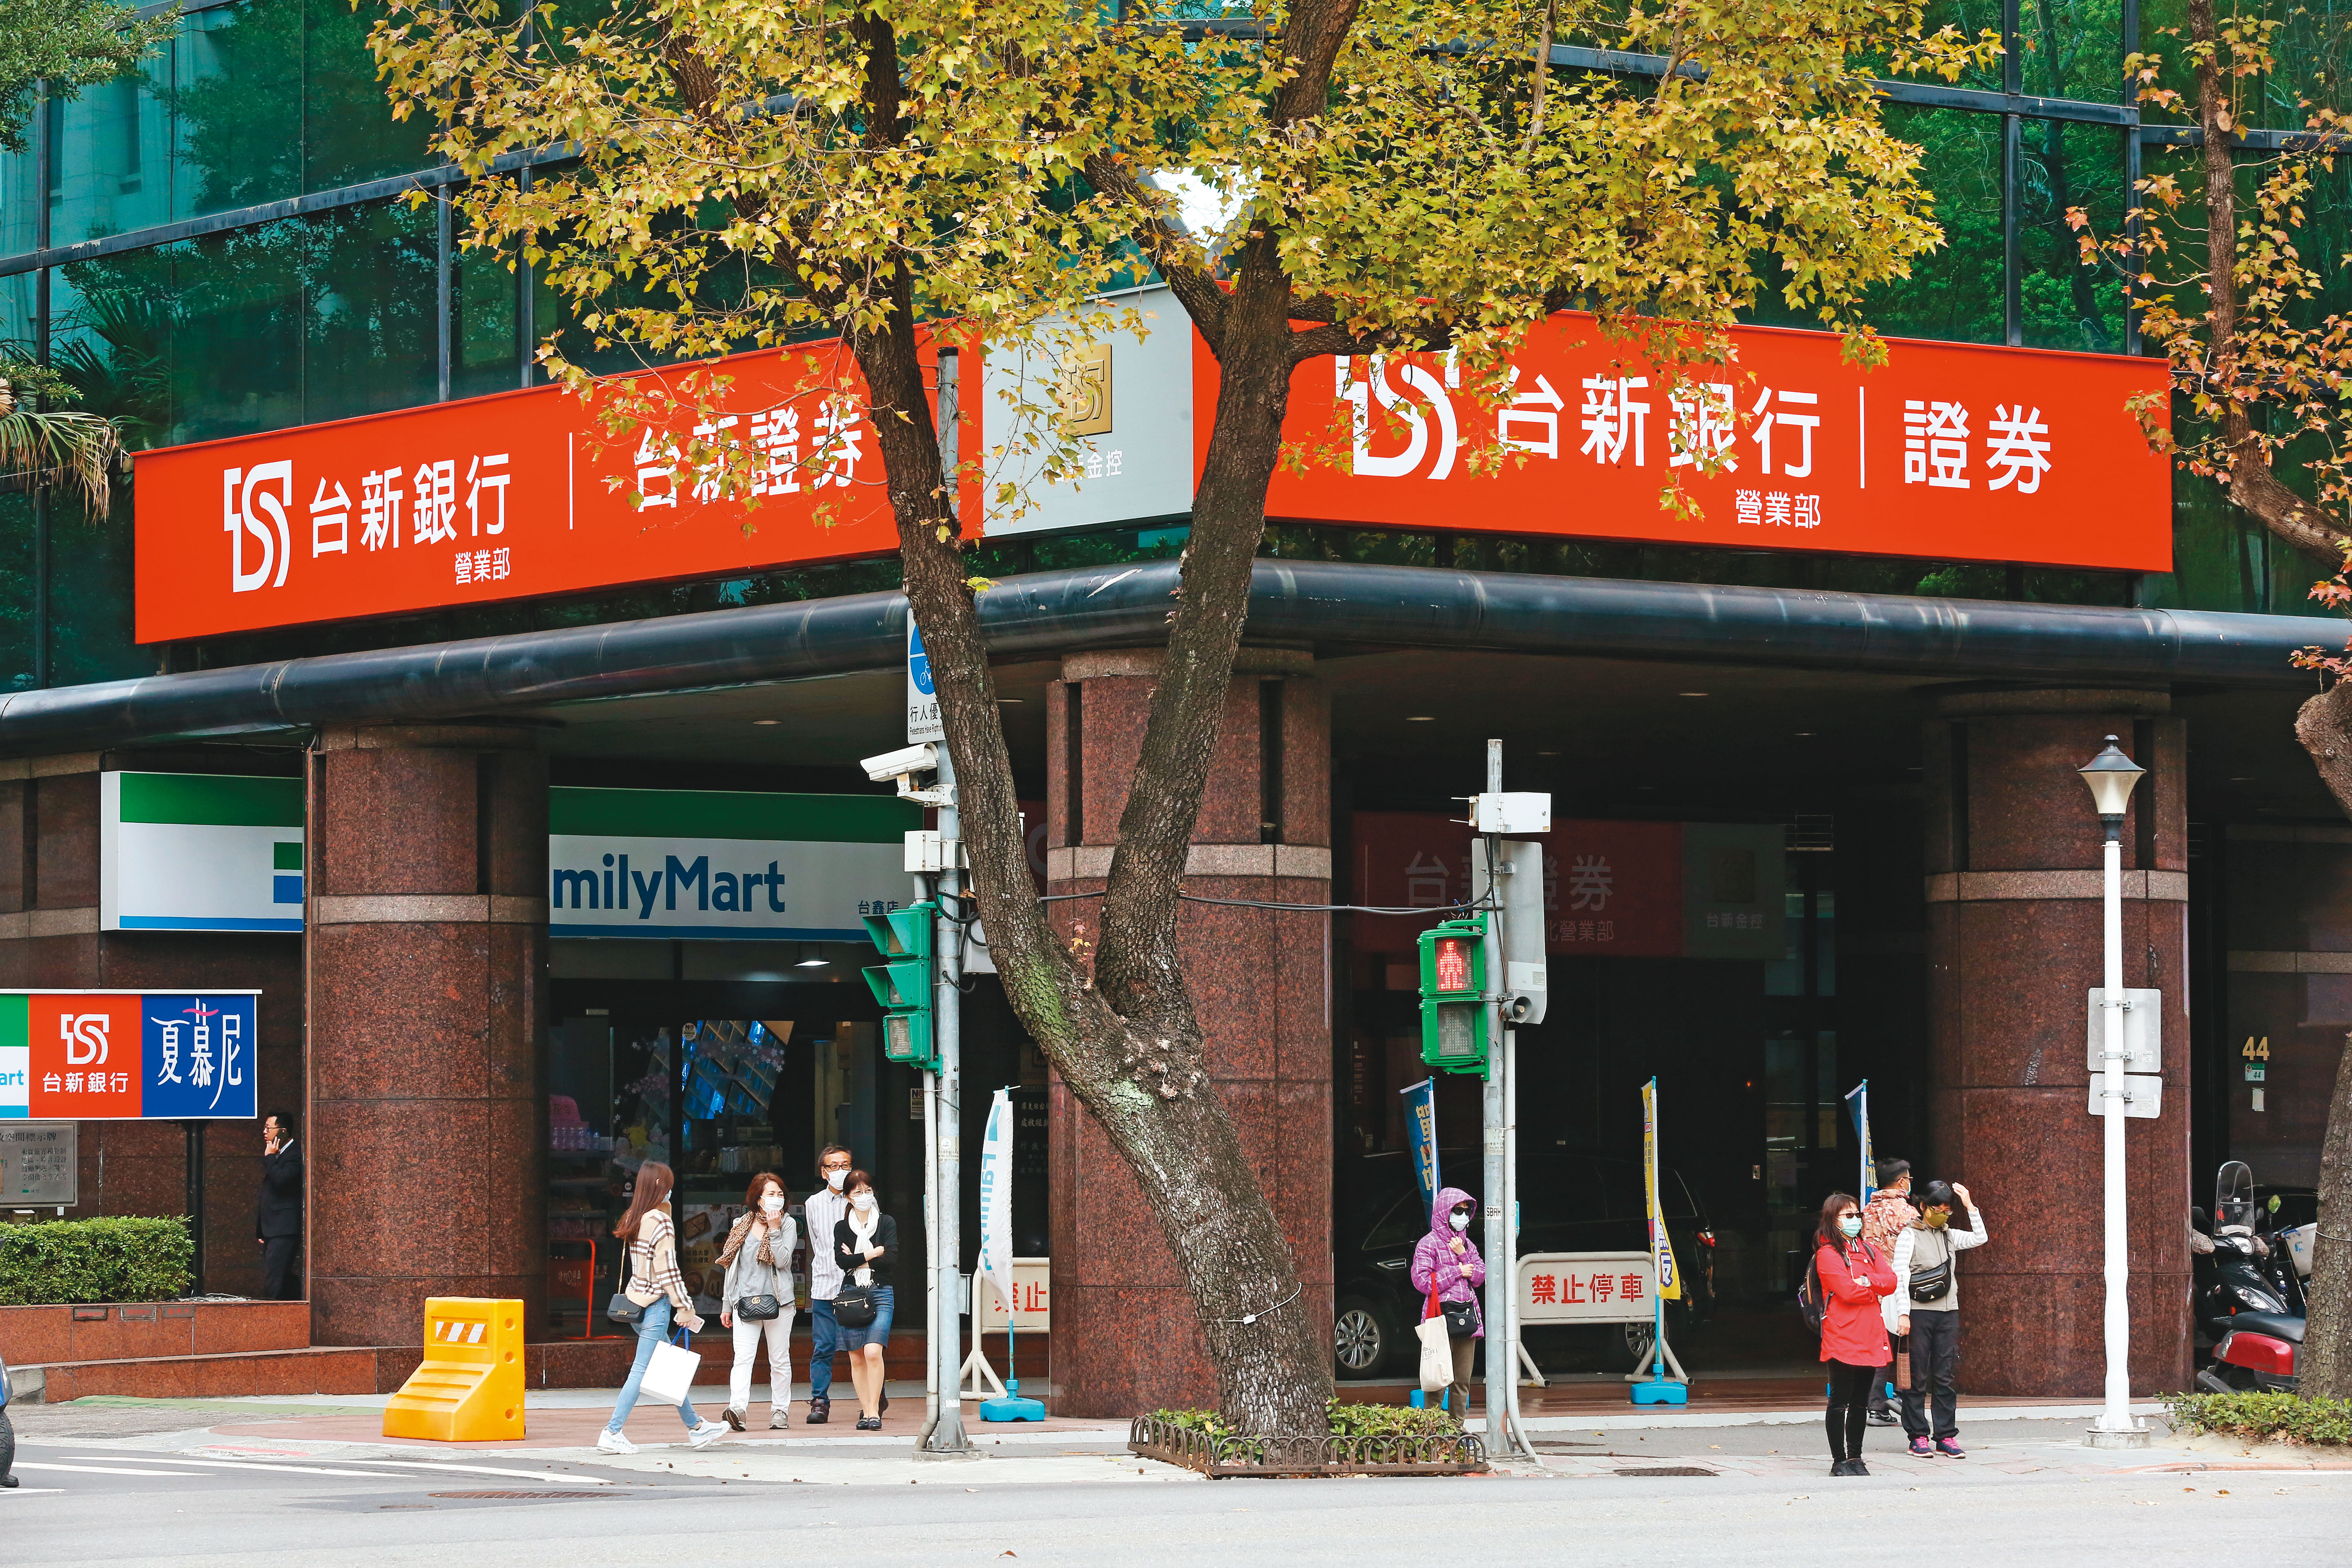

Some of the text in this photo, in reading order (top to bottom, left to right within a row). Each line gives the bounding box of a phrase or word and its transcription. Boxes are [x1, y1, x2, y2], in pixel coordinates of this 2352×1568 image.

[1494, 364, 2052, 494] 台新銀行 證券
[309, 453, 510, 558] 台新銀行
[1735, 488, 1821, 529] 營業部
[454, 547, 510, 585] 營業部
[858, 900, 899, 915] 台鑫店
[151, 998, 242, 1110] 夏慕尼
[2243, 1036, 2270, 1060] 44
[42, 1072, 128, 1093] 台新銀行
[1531, 1272, 1644, 1305] 禁止停車
